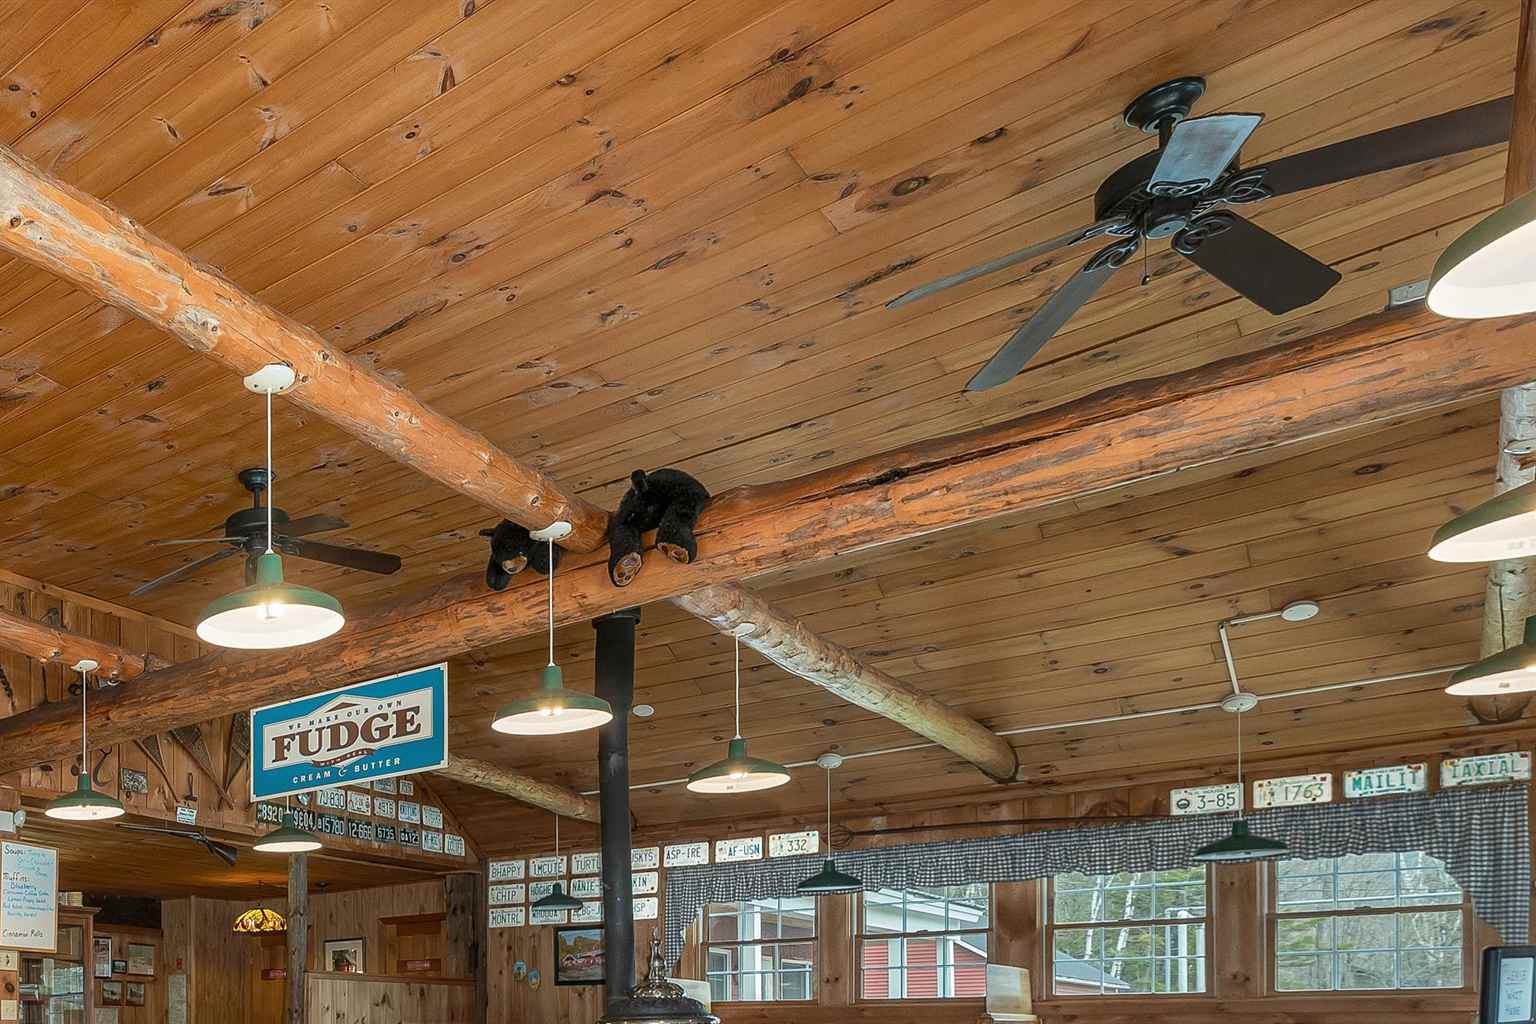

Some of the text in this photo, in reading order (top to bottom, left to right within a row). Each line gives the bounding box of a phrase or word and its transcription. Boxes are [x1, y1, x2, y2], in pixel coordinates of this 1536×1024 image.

[309, 714, 339, 726] MAKE
[347, 708, 369, 717] OUR
[378, 700, 402, 711] OWN
[271, 705, 422, 763] FUDGE
[292, 770, 331, 784] CREAM
[354, 757, 401, 773] BUTTER
[1197, 792, 1235, 809] 3-85
[576, 858, 601, 872] TURTL
